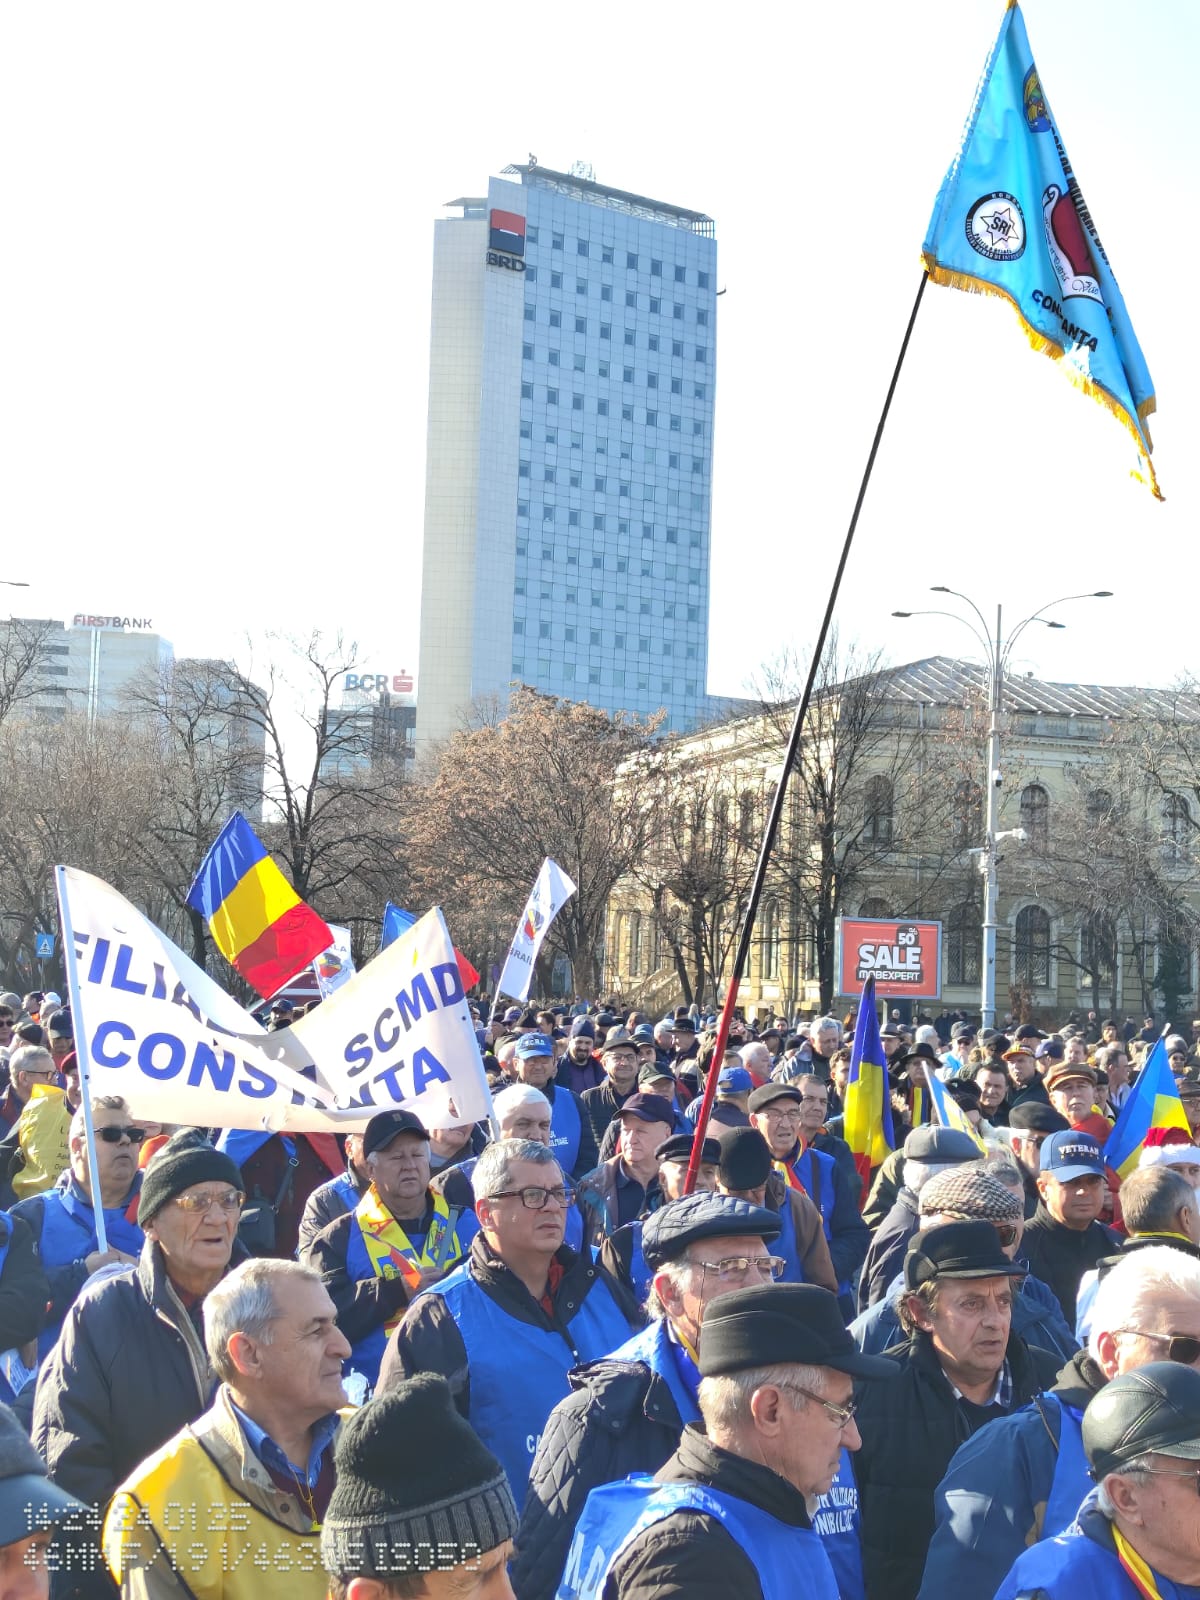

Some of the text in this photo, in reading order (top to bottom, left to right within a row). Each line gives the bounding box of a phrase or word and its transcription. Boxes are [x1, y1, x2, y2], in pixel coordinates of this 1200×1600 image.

[991, 217, 1011, 236] SRI
[486, 251, 526, 273] BRD
[73, 614, 152, 629] FIRSTBANK
[345, 674, 389, 692] BCR
[859, 944, 921, 970] SALE
[344, 962, 466, 1078] SCMD
[1058, 1144, 1099, 1155] VETERAN
